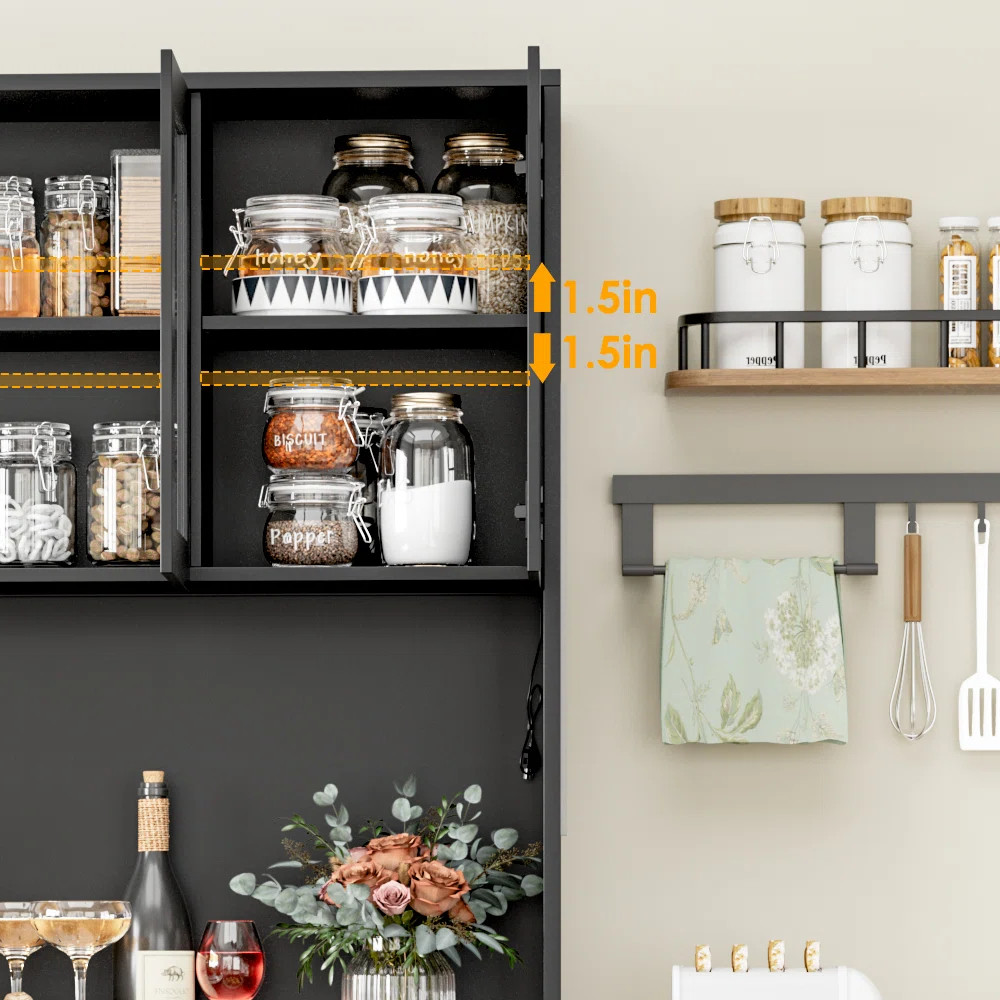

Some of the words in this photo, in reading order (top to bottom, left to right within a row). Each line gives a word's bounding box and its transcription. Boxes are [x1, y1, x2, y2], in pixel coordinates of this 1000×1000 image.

[256, 249, 321, 269] honey
[404, 247, 464, 269] honey
[274, 433, 328, 447] BISCUIT
